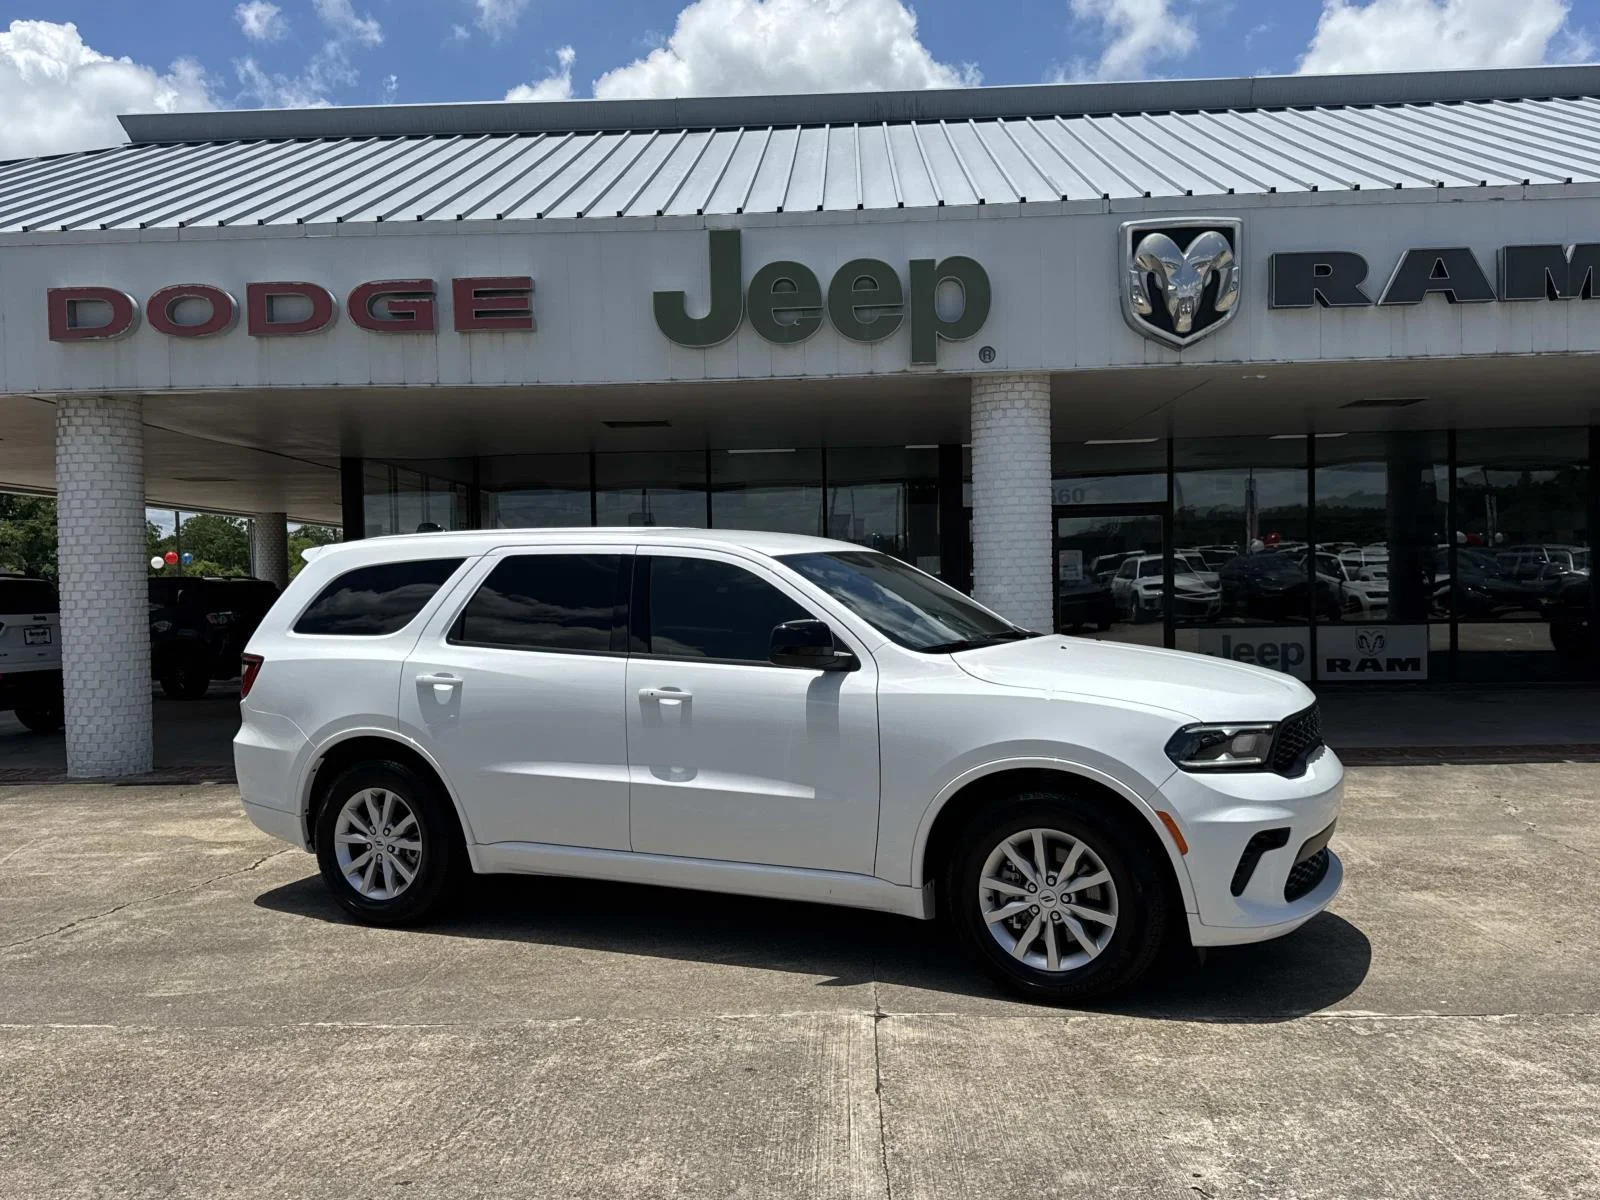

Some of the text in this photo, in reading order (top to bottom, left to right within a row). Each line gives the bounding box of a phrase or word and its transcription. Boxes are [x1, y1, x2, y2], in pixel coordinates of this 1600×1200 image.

[47, 276, 536, 342] DODGE
[652, 229, 992, 365] Jeep
[1268, 243, 1600, 310] RAM
[1326, 657, 1421, 673] RAM
